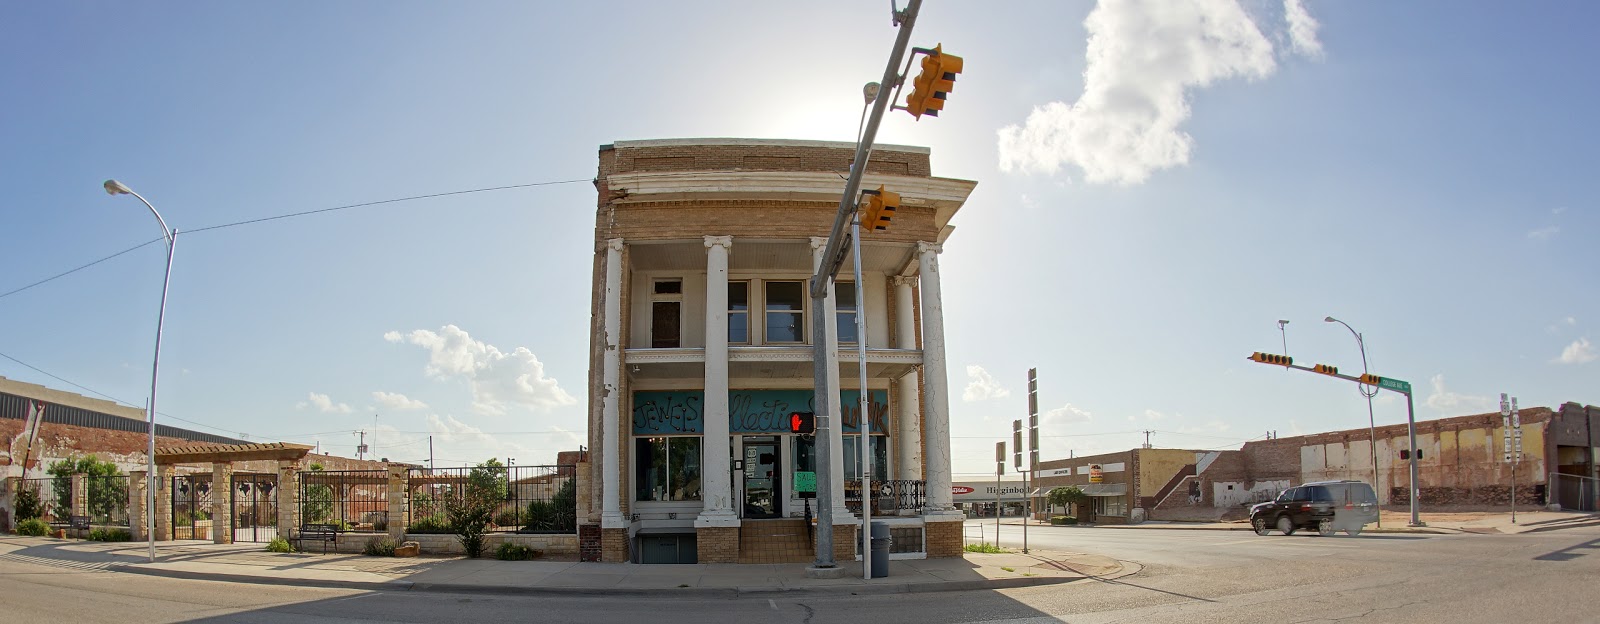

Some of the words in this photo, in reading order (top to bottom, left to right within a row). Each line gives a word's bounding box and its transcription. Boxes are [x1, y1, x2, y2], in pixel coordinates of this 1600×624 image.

[1383, 380, 1397, 388] COLLEGE
[632, 396, 699, 432] JEWELS
[702, 394, 793, 432] llectio
[843, 392, 890, 437] UNK
[797, 473, 816, 482] SALE
[986, 486, 1031, 495] Higginboh
